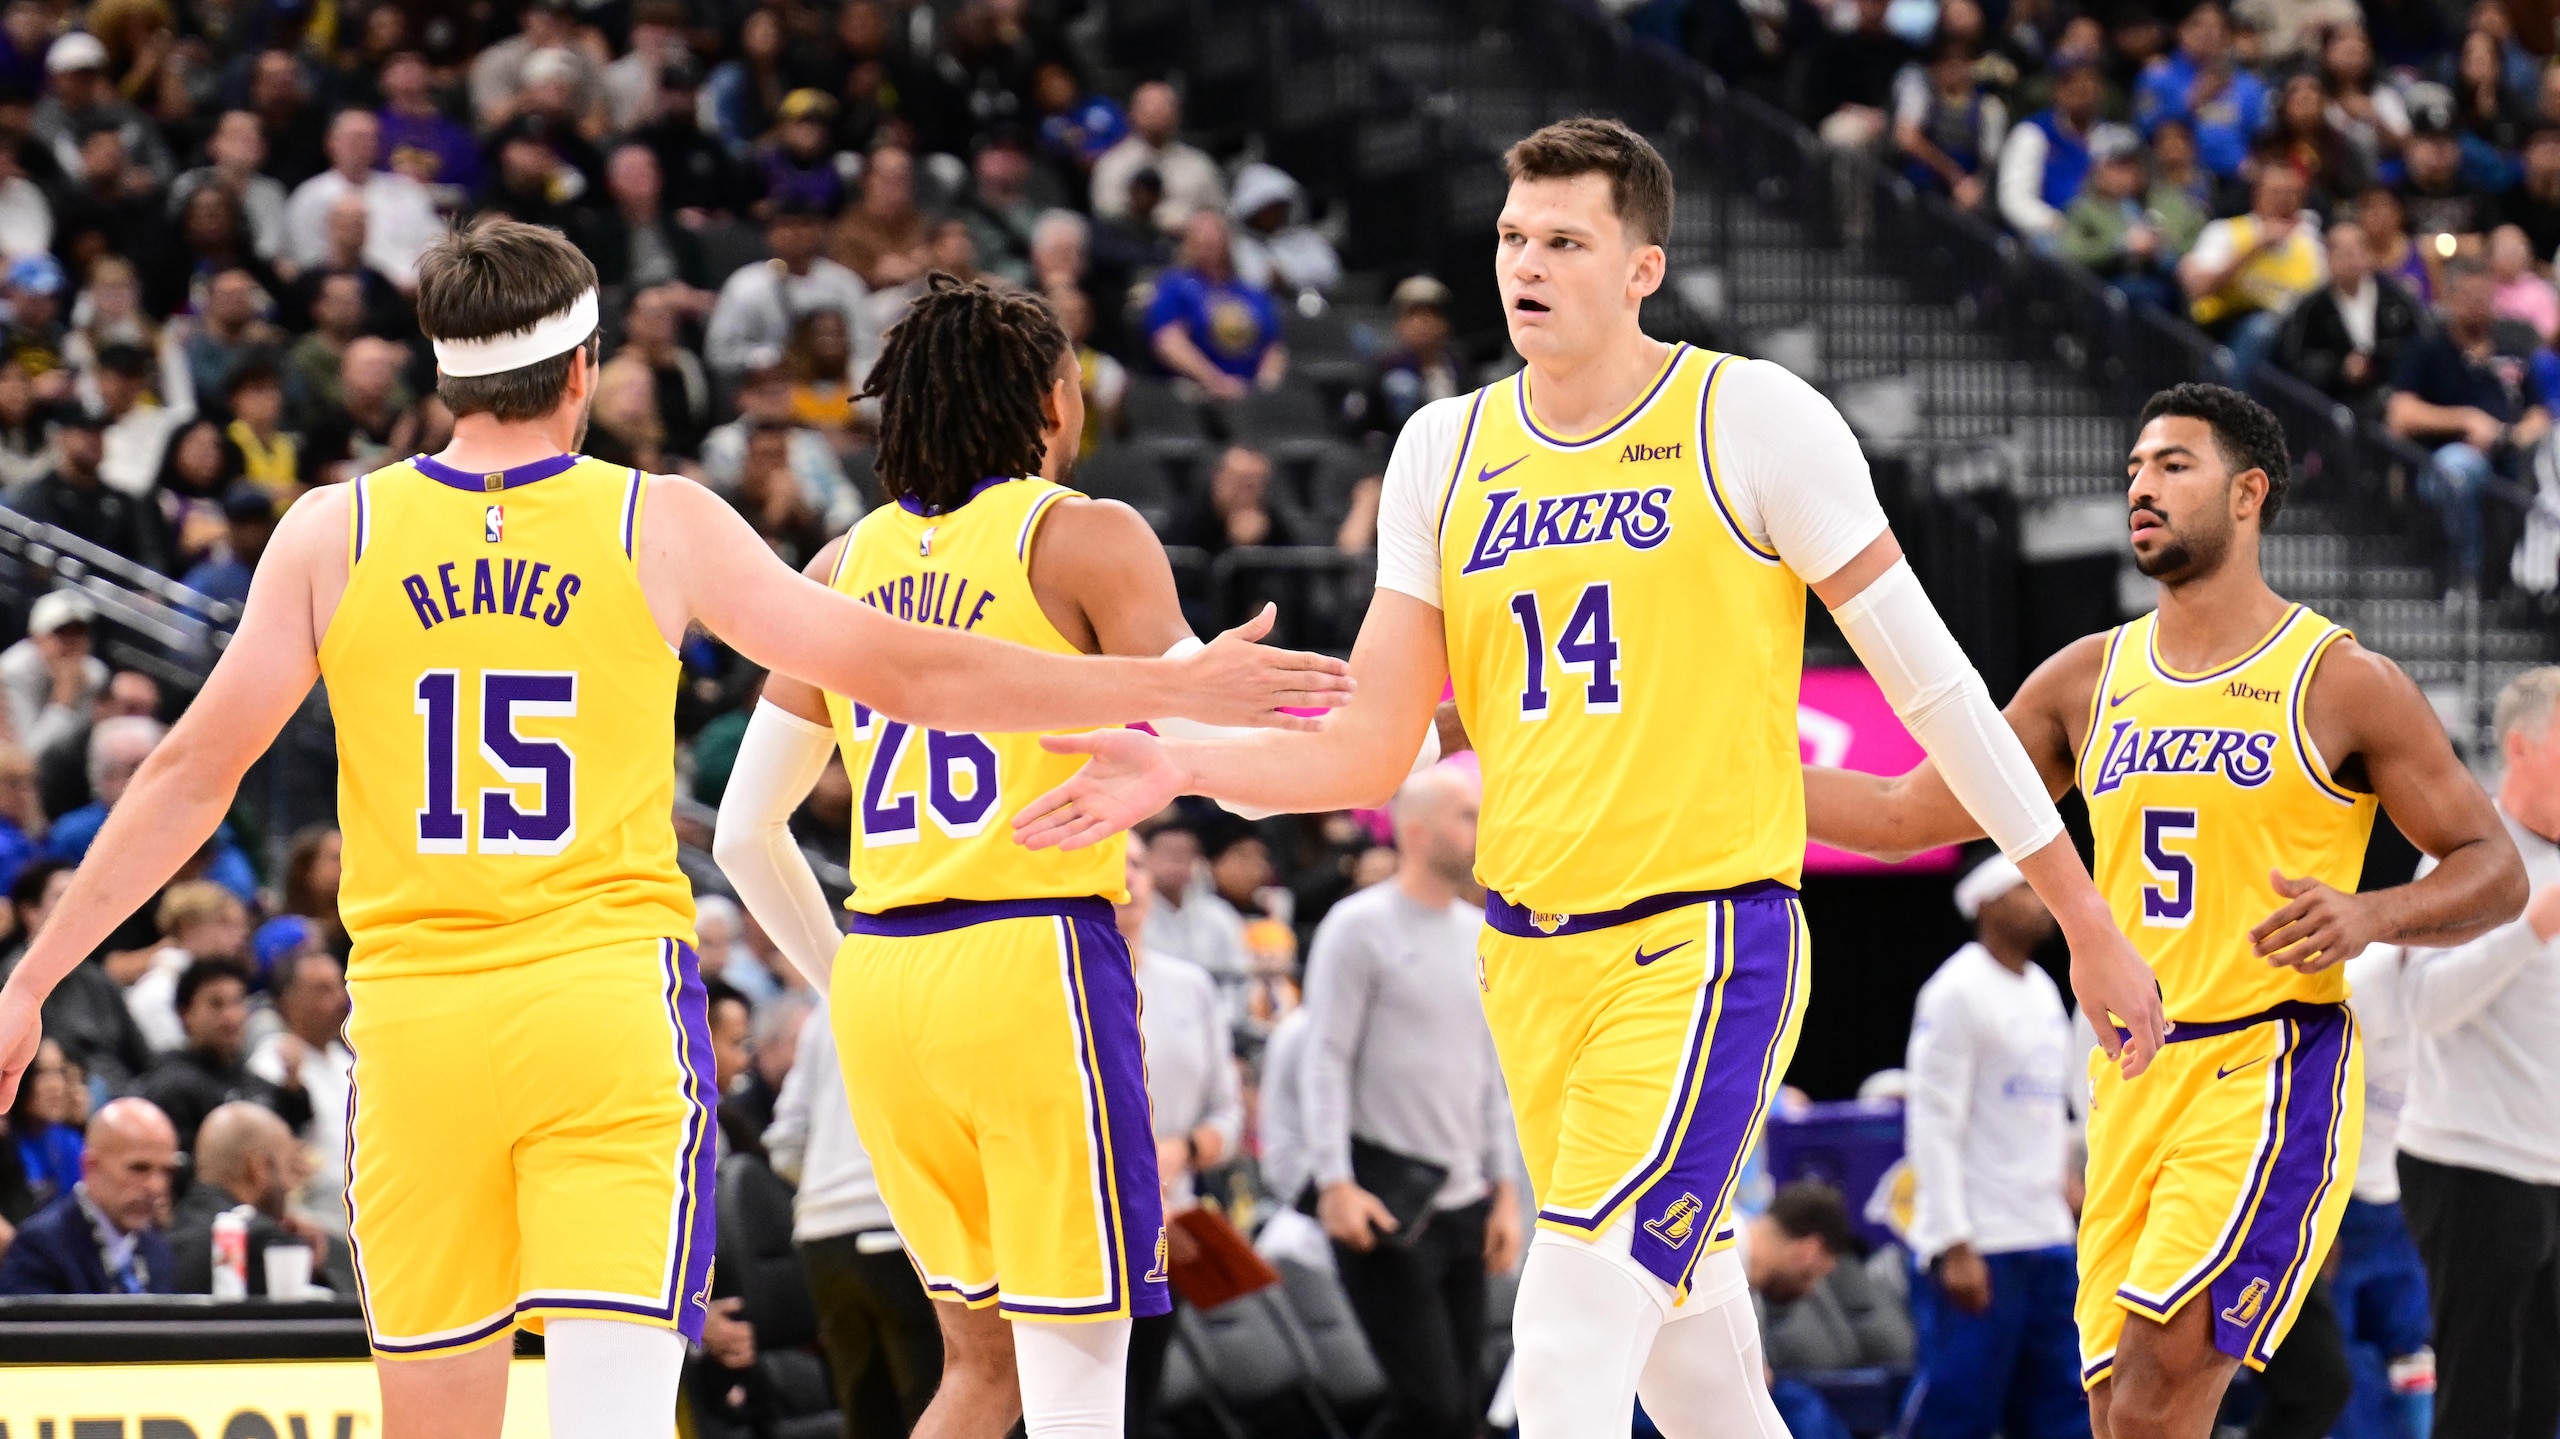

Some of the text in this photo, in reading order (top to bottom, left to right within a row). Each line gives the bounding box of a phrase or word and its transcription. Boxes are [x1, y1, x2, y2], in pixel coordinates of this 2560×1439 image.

[1619, 443, 1683, 463] Albert
[1461, 484, 1675, 576] LAKERS
[401, 557, 582, 631] REAVES
[859, 571, 996, 631] YBULLE
[1508, 580, 1622, 723] 14
[2222, 681, 2281, 704] Albert
[414, 668, 579, 856] 15
[850, 698, 1002, 849] 26
[2092, 716, 2280, 797] LAKERS
[2141, 806, 2198, 929] 5
